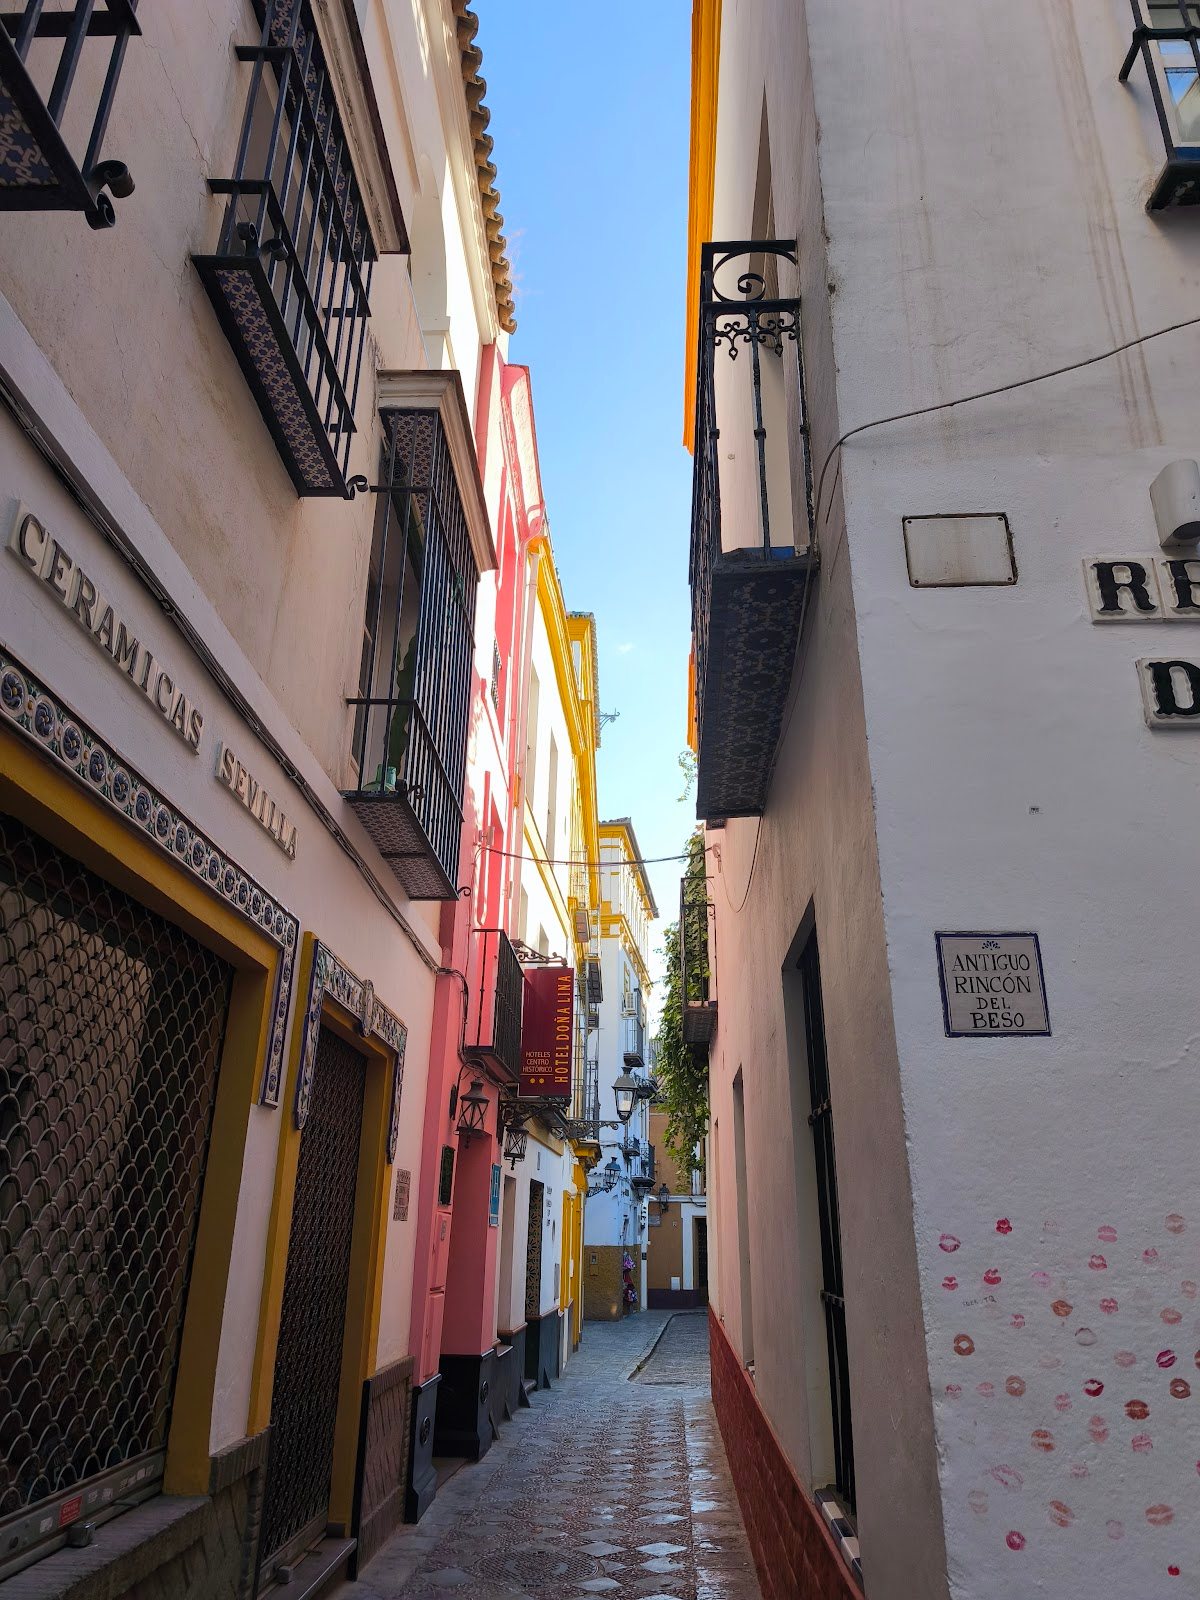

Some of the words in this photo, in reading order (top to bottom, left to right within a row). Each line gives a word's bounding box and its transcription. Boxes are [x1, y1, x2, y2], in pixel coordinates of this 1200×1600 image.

[19, 513, 204, 747] CERAMICAS
[221, 747, 297, 859] SEVILLA
[951, 953, 1031, 972] ANTIGUO
[557, 975, 572, 1004] LINA
[953, 971, 1032, 994] RINCÓN
[975, 997, 1011, 1010] DEL
[554, 1006, 571, 1041] DOÑA
[969, 1011, 1025, 1029] BESO
[522, 1064, 552, 1072] HISTÓRICO
[554, 1044, 569, 1083] HOTEL
